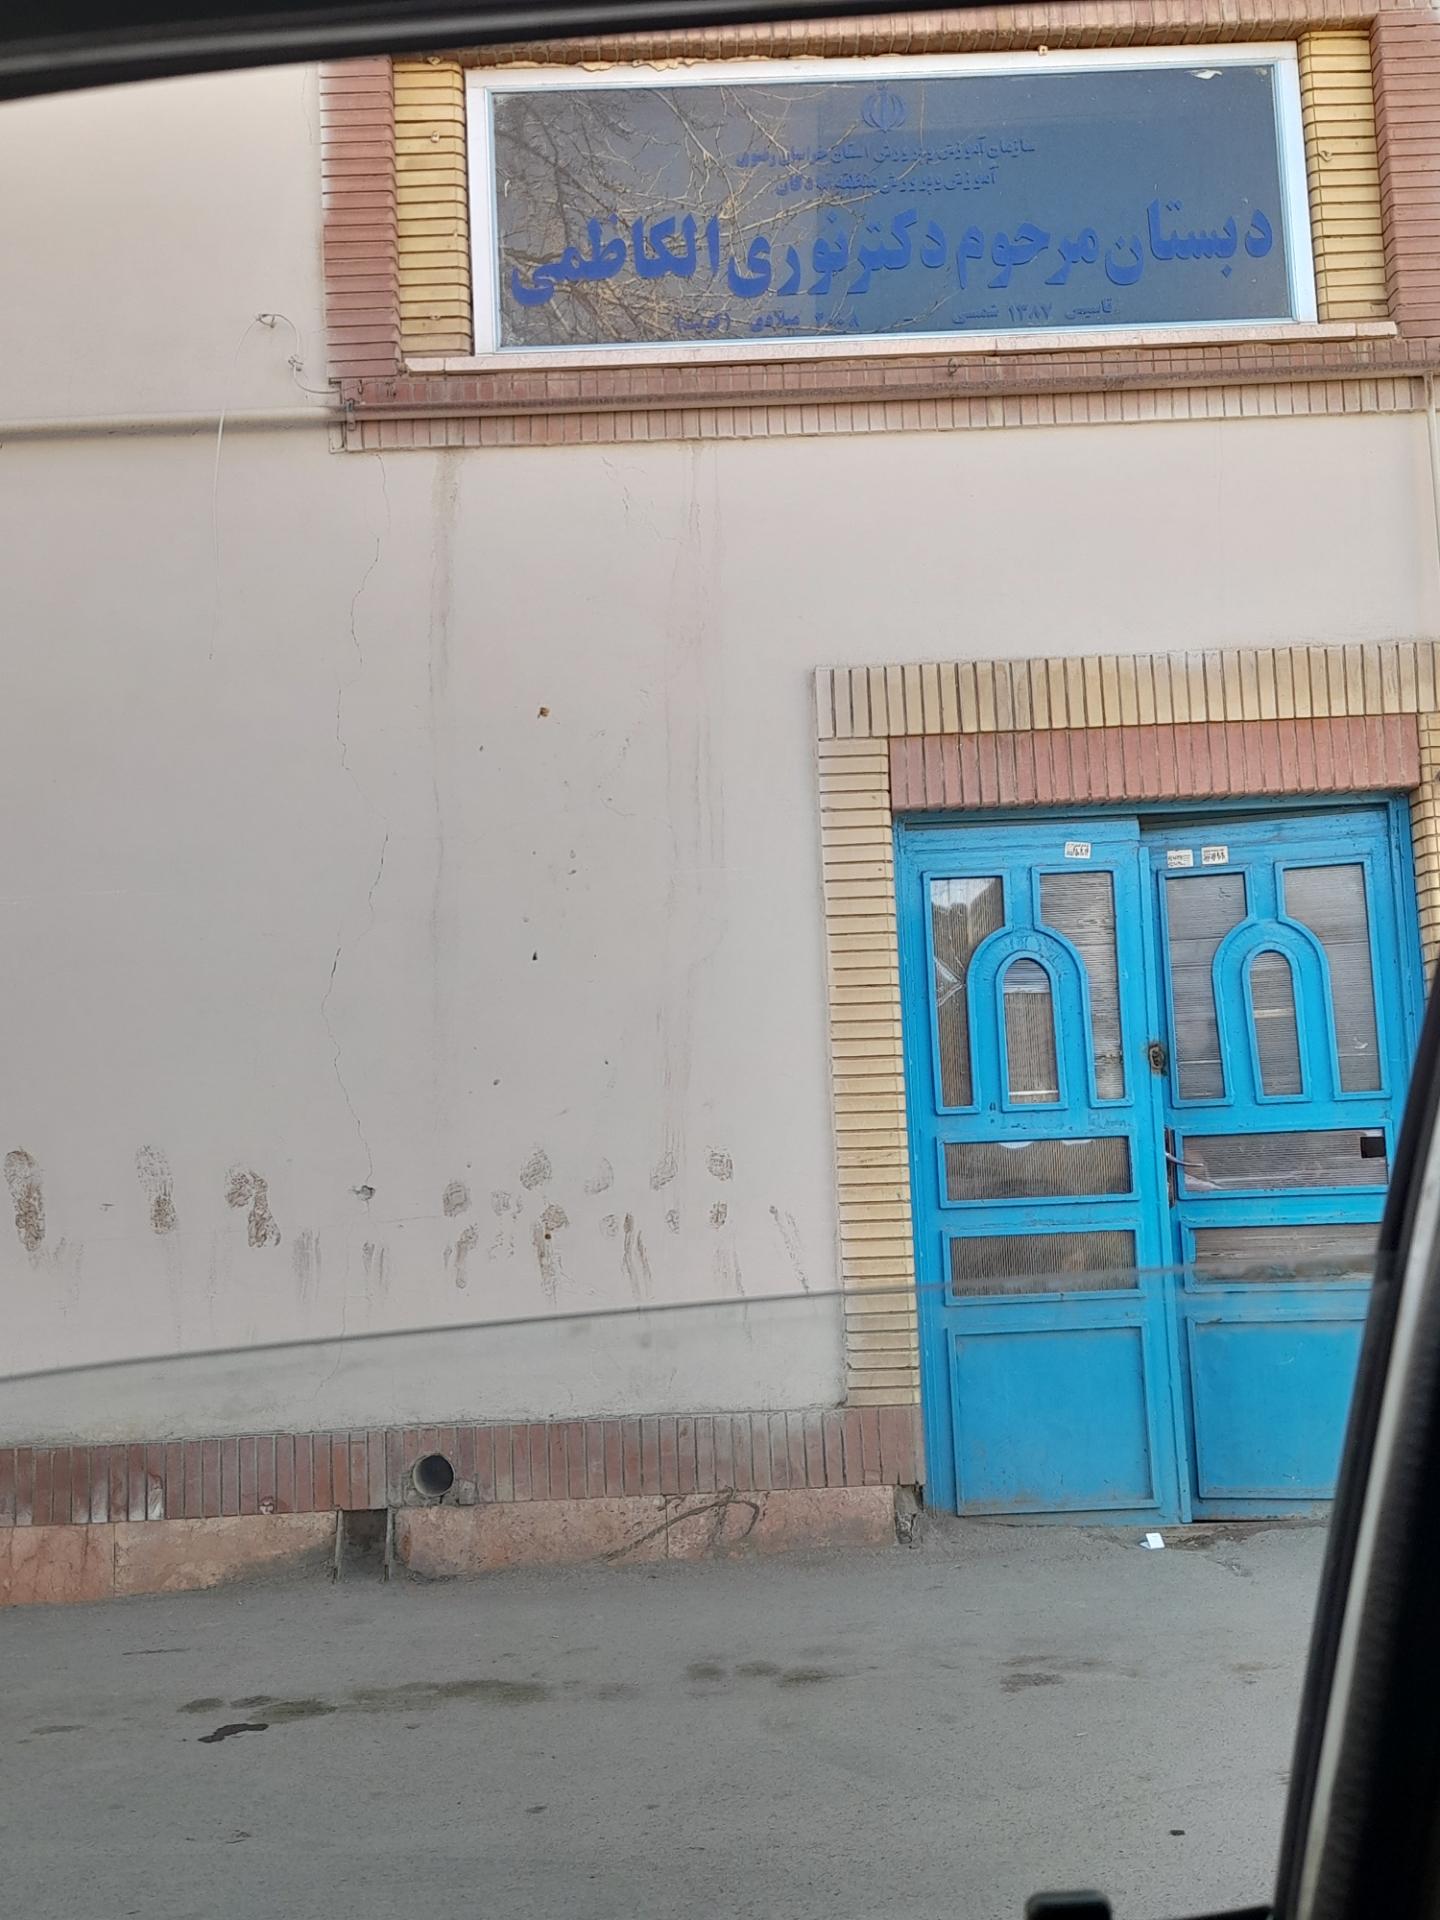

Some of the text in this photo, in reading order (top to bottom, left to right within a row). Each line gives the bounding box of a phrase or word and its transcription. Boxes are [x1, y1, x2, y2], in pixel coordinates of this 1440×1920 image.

[830, 143, 870, 165] استان
[511, 199, 1274, 307] دبستان مرحوم دکتر نوری الکاظمی
